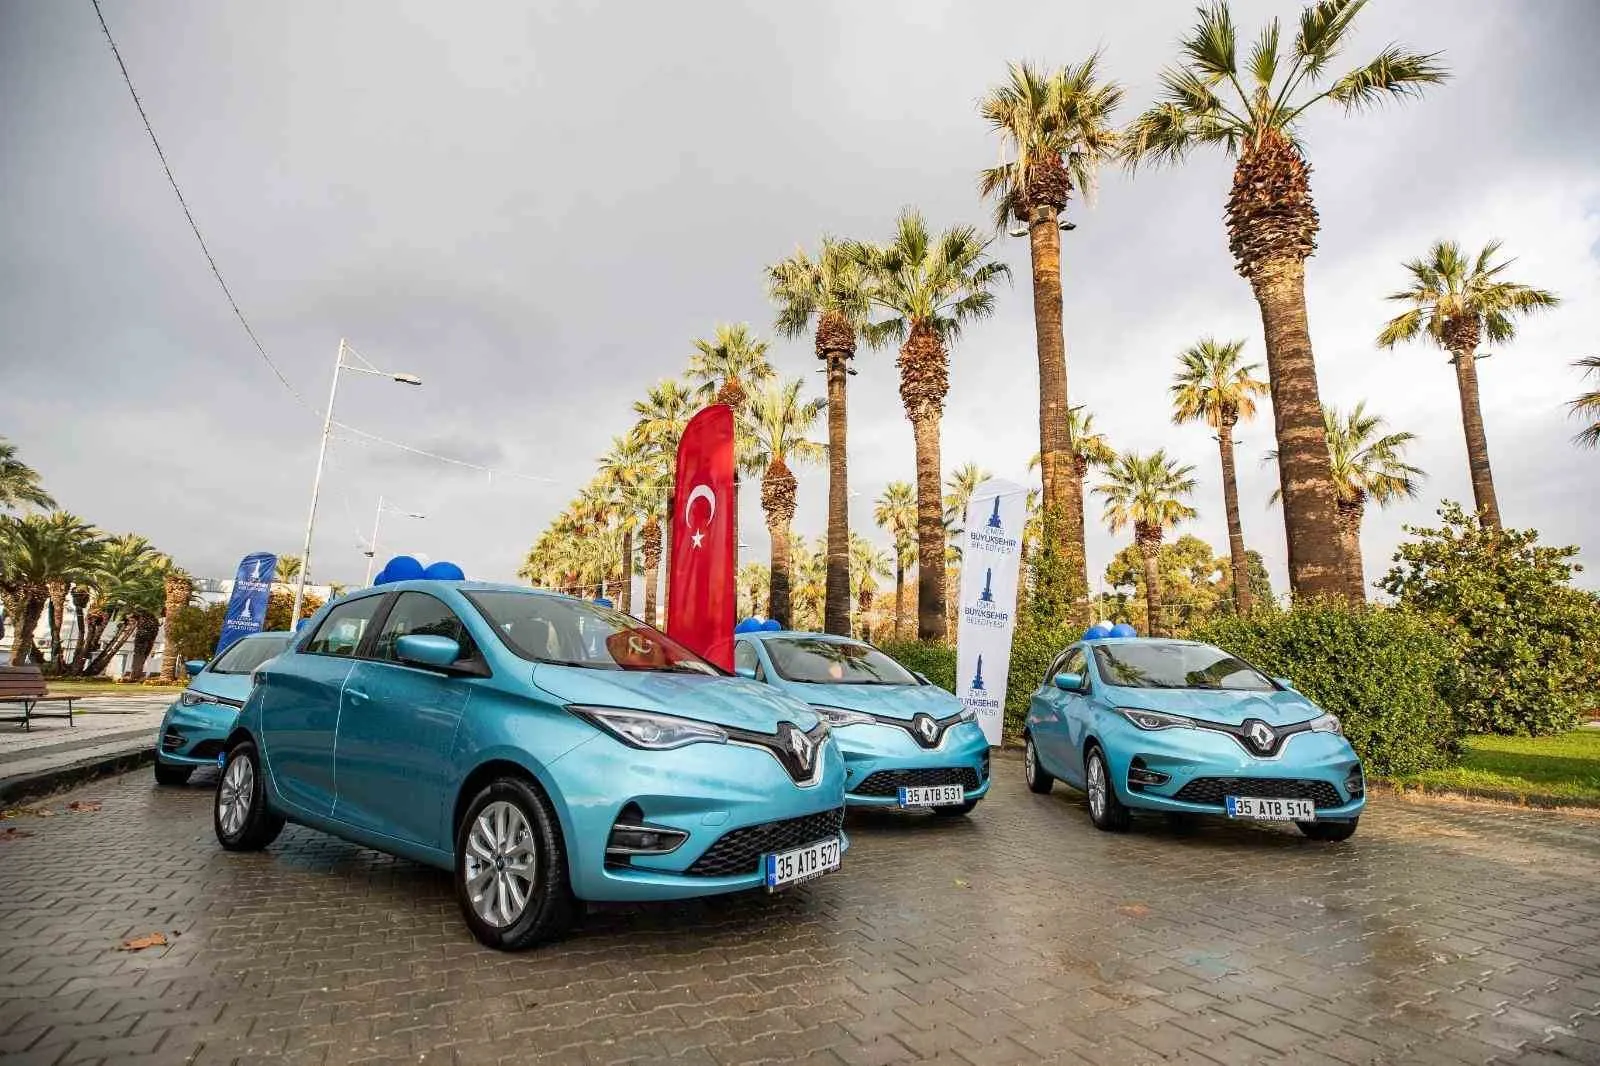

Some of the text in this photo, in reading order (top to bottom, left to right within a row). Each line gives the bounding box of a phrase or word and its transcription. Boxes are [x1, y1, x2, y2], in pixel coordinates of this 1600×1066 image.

[907, 789, 920, 803] 35
[924, 788, 941, 801] ATB
[944, 786, 961, 800] 531
[1236, 800, 1252, 814] 35
[1259, 800, 1282, 815] ATB
[1287, 802, 1311, 816] 514
[778, 855, 793, 880] 35
[798, 849, 817, 874] ATB
[821, 842, 838, 866] 527
